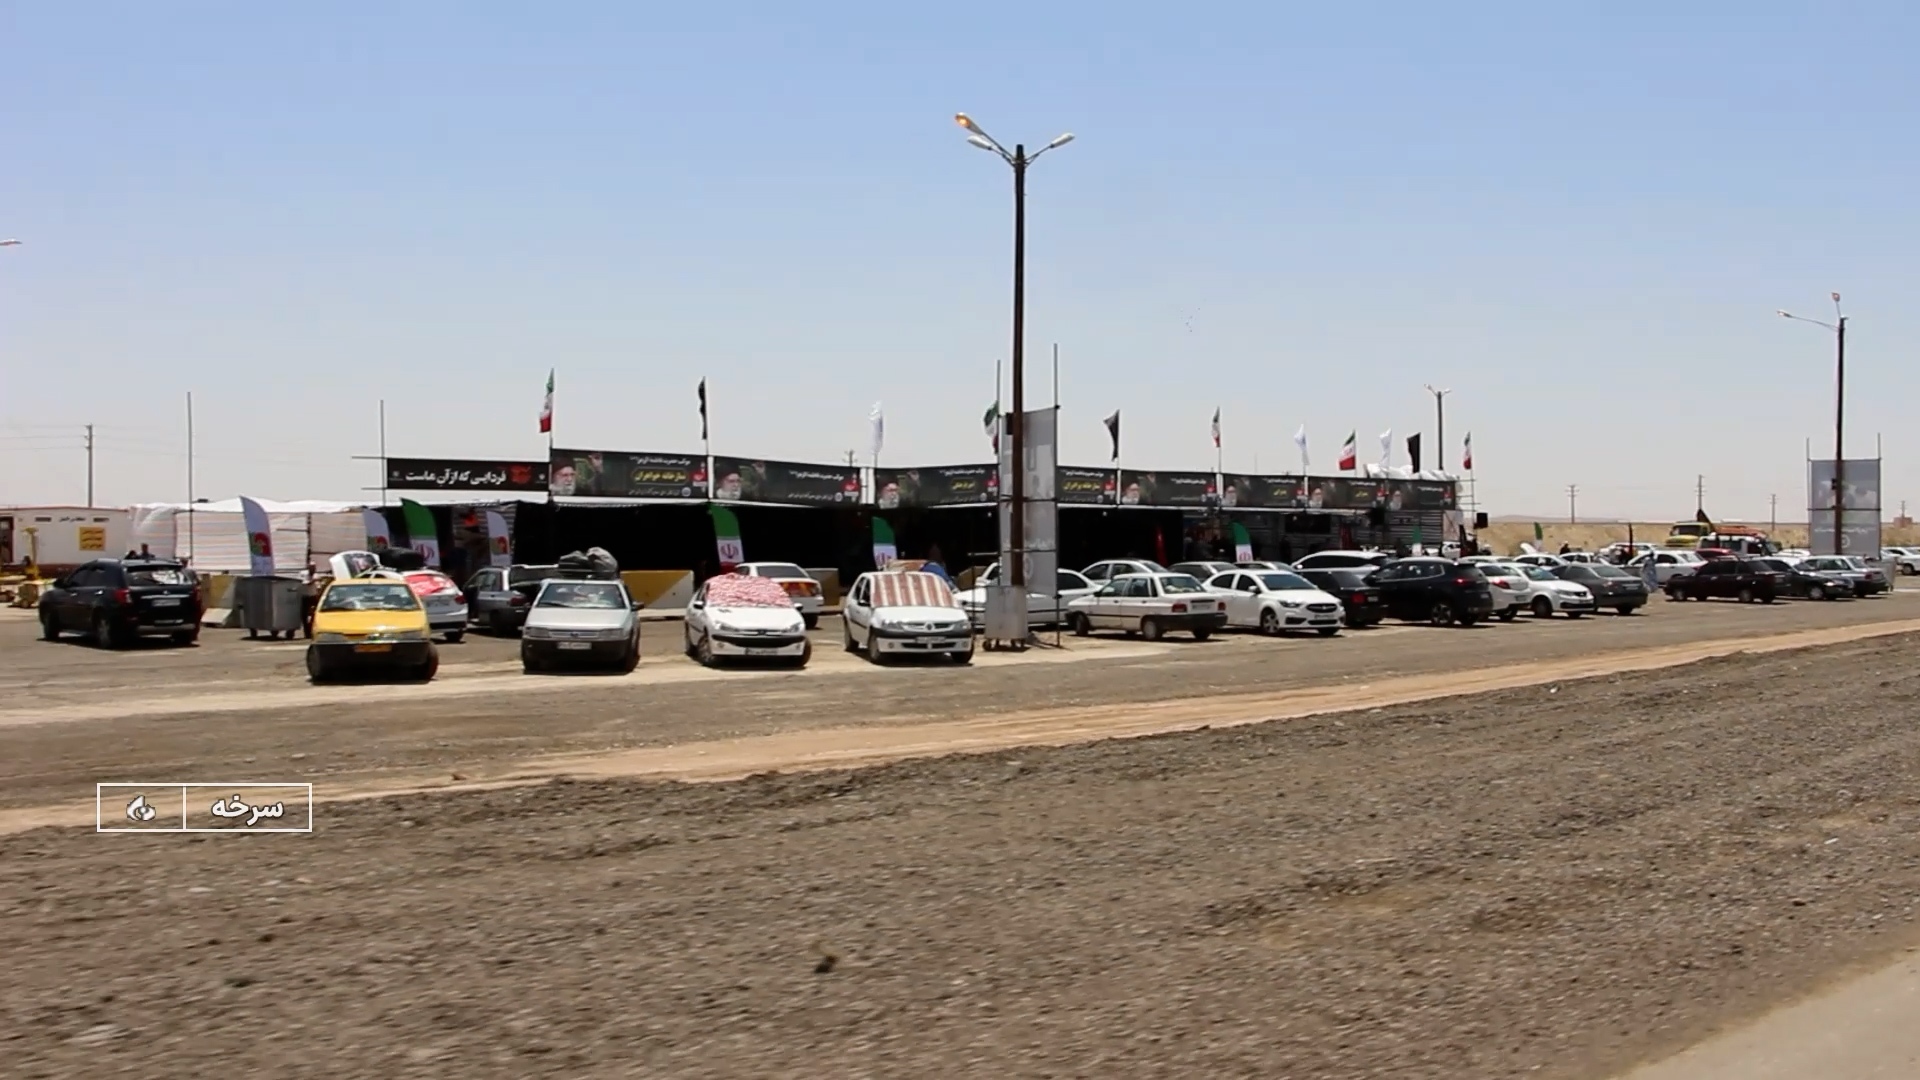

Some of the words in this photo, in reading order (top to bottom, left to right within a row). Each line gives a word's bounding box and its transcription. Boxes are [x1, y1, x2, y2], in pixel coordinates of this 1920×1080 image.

[405, 470, 436, 482] ماست
[449, 470, 459, 485] از
[459, 470, 471, 482] که
[470, 470, 507, 485] فردایی
